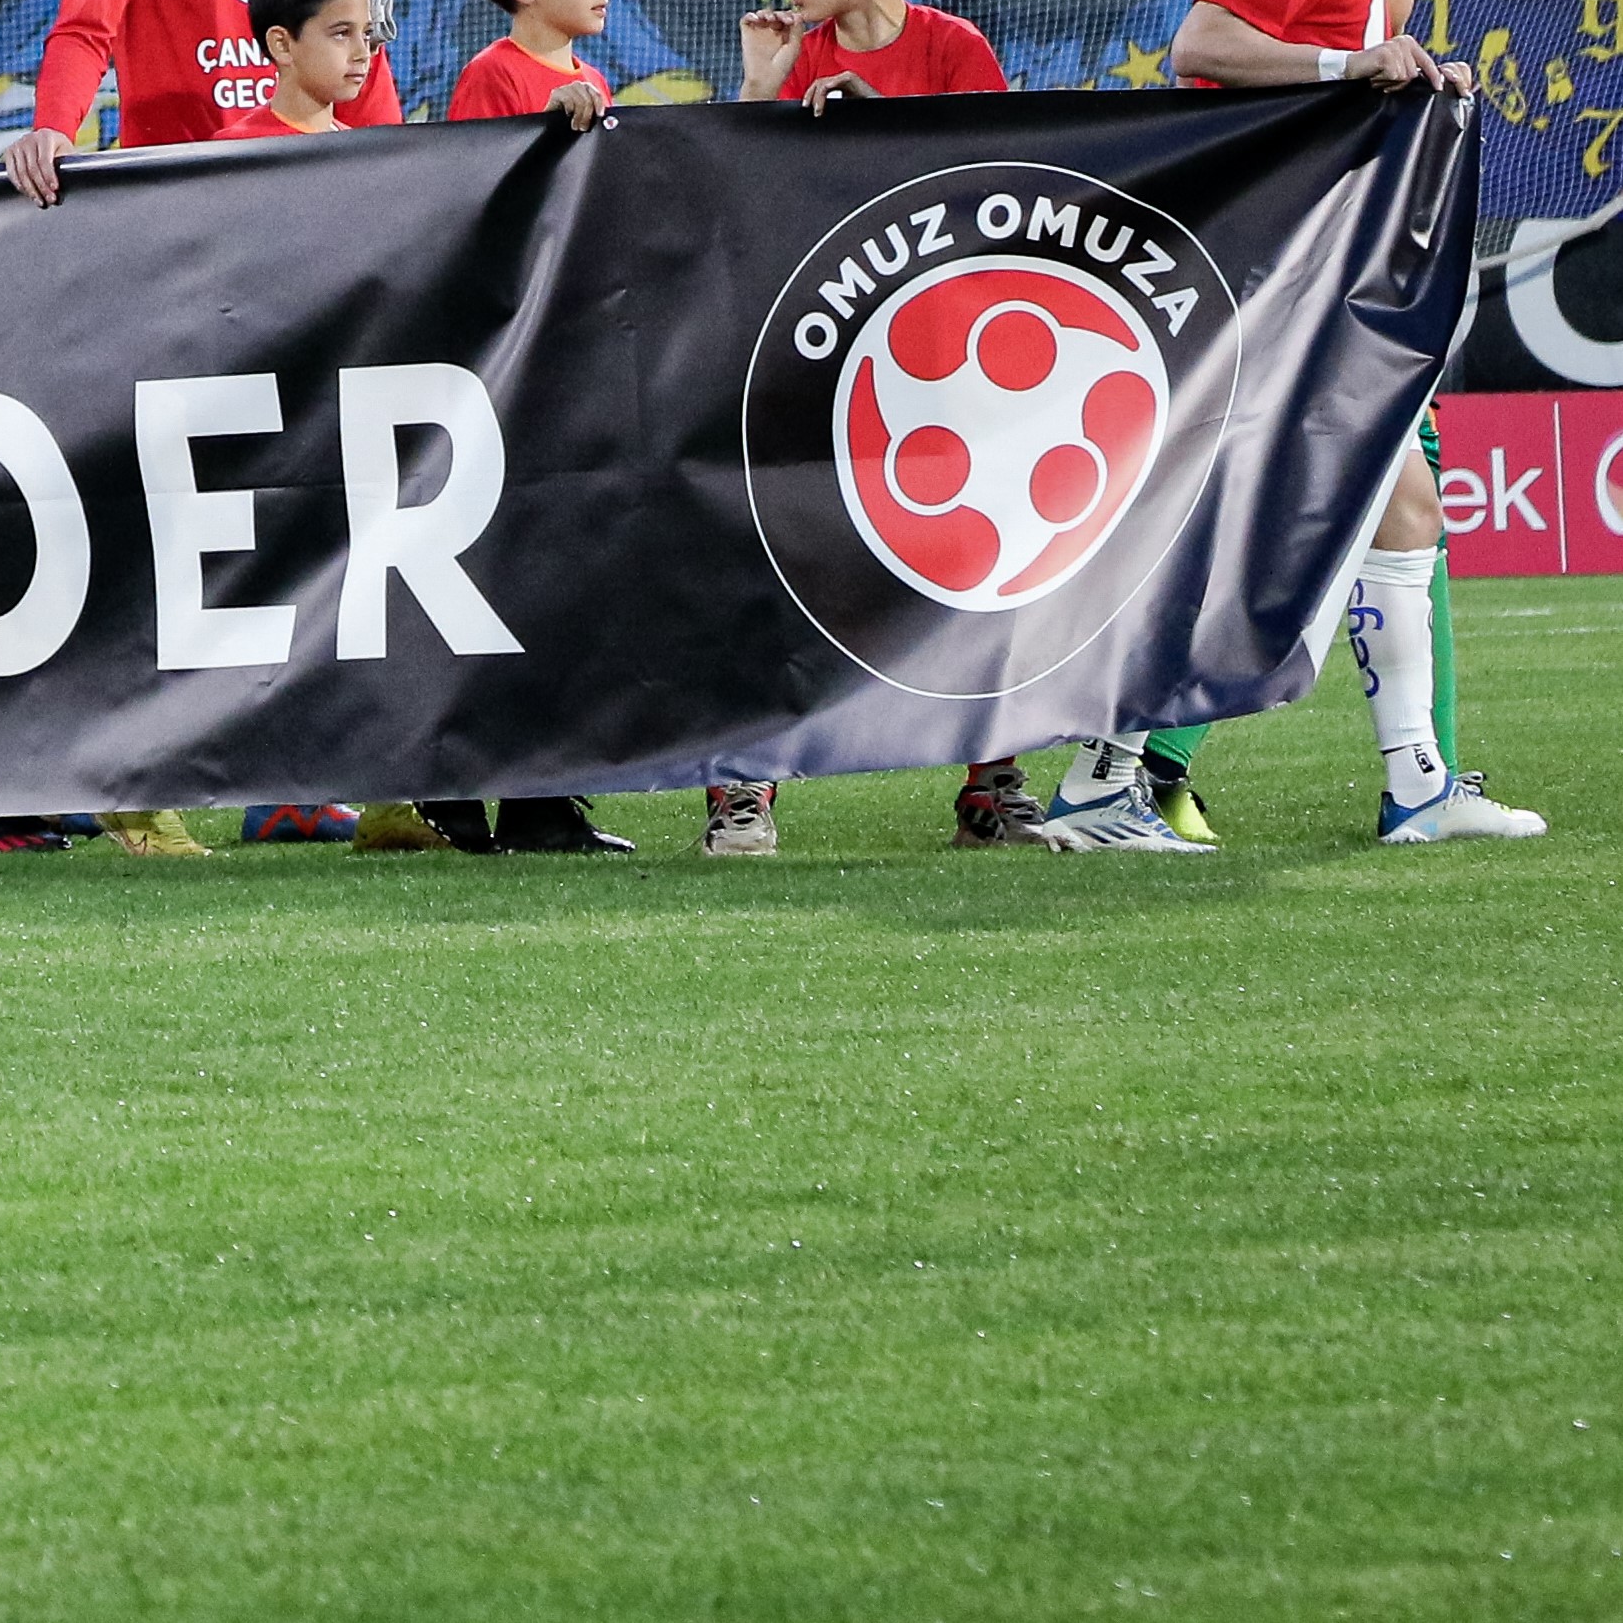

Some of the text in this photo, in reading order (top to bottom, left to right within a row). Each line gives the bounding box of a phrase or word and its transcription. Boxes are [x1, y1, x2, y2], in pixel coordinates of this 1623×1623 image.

[196, 37, 271, 73] ÇAN
[794, 192, 1201, 361] OMUZ OMUZA
